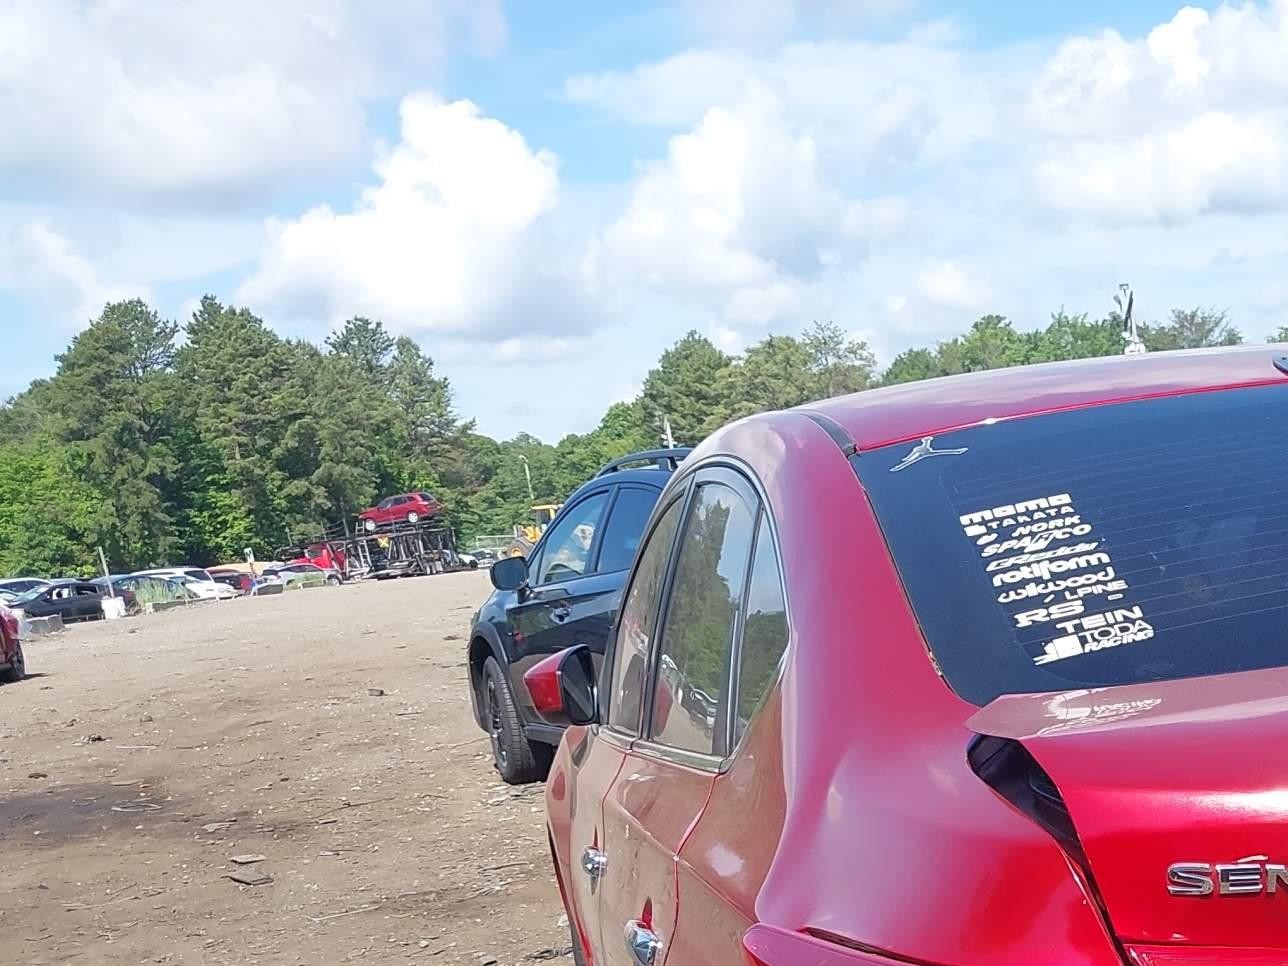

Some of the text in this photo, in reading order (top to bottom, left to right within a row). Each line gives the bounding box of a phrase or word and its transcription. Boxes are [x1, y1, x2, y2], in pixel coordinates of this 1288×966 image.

[988, 505, 1075, 529] TAKATA
[992, 552, 1110, 587] rotiform
[1056, 605, 1143, 633] TEIN
[1079, 619, 1152, 643] TODA
[1083, 629, 1154, 653] RACING
